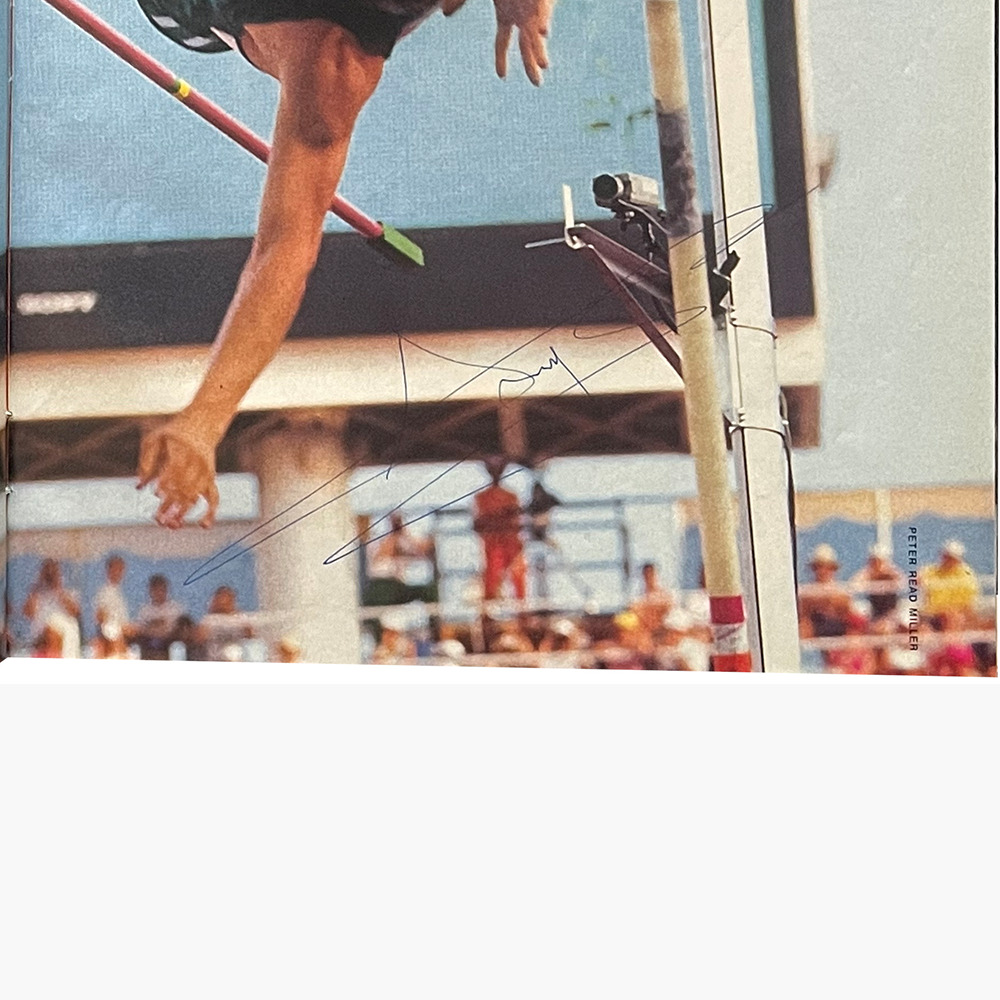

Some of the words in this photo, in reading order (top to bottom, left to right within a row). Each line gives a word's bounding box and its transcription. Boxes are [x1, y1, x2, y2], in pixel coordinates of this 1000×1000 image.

[908, 527, 917, 565] PETER
[908, 571, 917, 603] READ
[909, 608, 918, 651] MILLER
